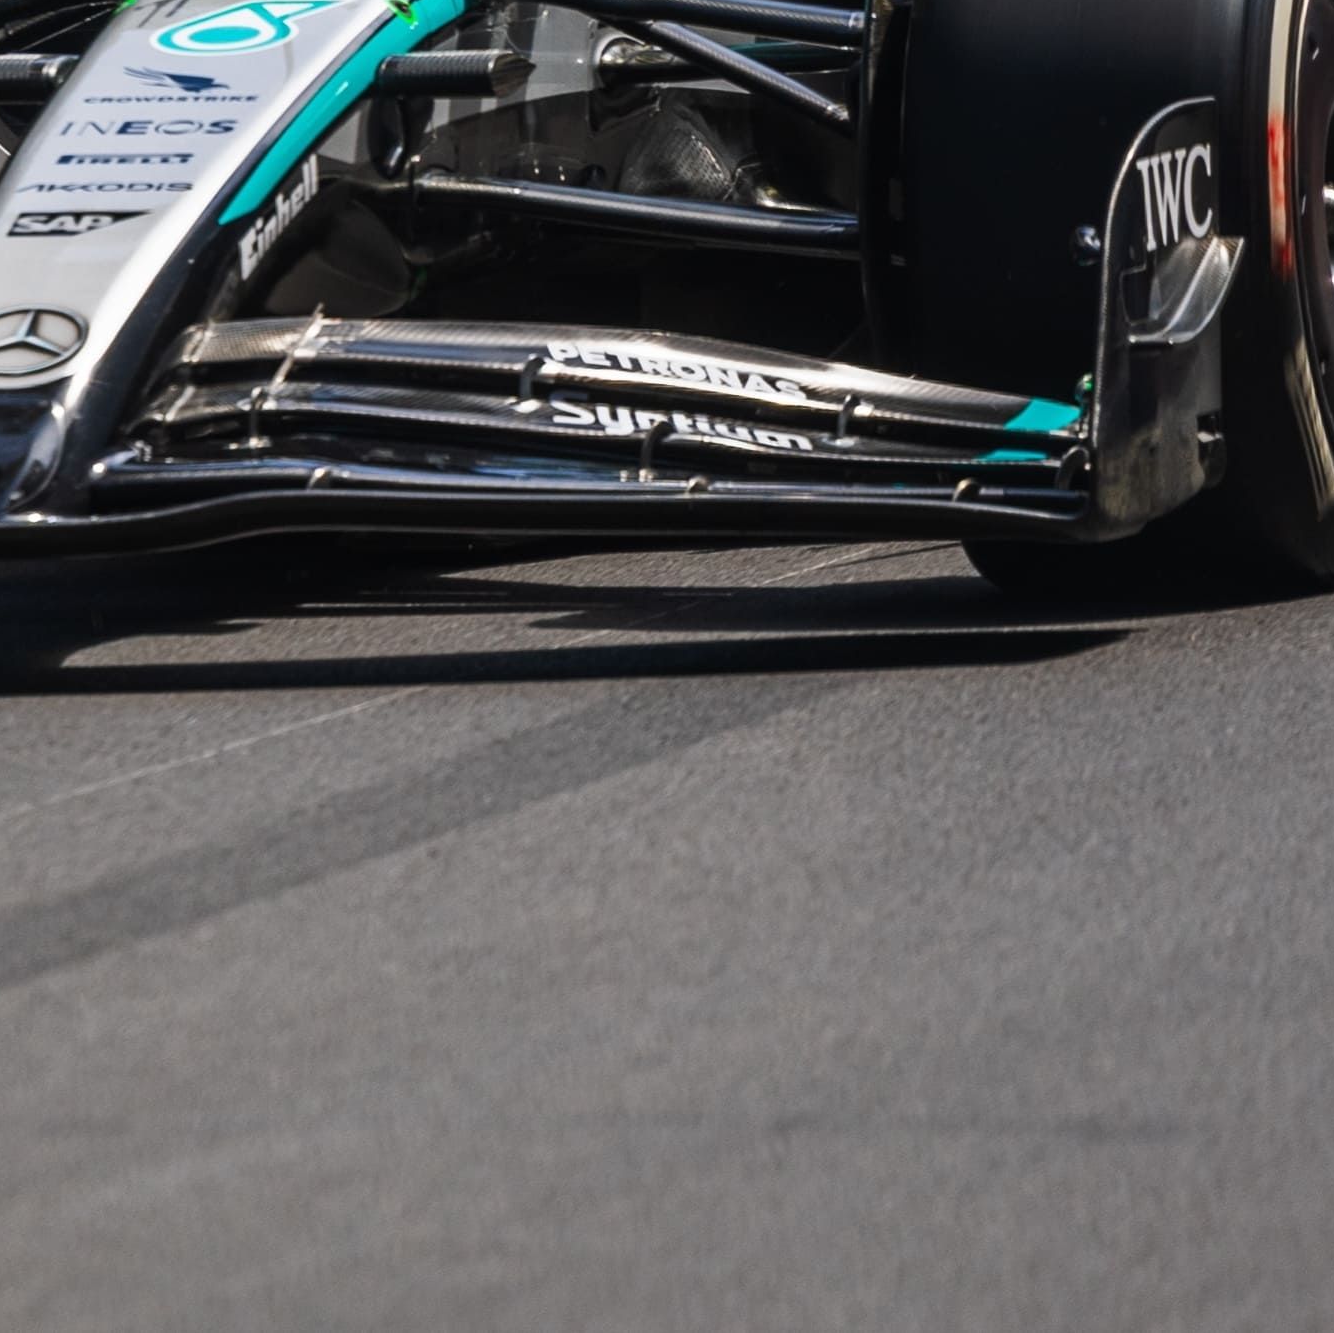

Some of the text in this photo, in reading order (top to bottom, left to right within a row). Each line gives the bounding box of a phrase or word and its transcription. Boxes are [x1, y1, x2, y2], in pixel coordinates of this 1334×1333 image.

[83, 95, 259, 104] CROWDSTRIKE
[60, 120, 238, 136] INEOS
[55, 153, 195, 165] PIRELLI
[238, 153, 319, 282] Einhell
[1136, 143, 1213, 253] IWC
[11, 215, 115, 233] SAP
[546, 341, 807, 401] PETRONAS
[547, 390, 813, 451] Syntium
